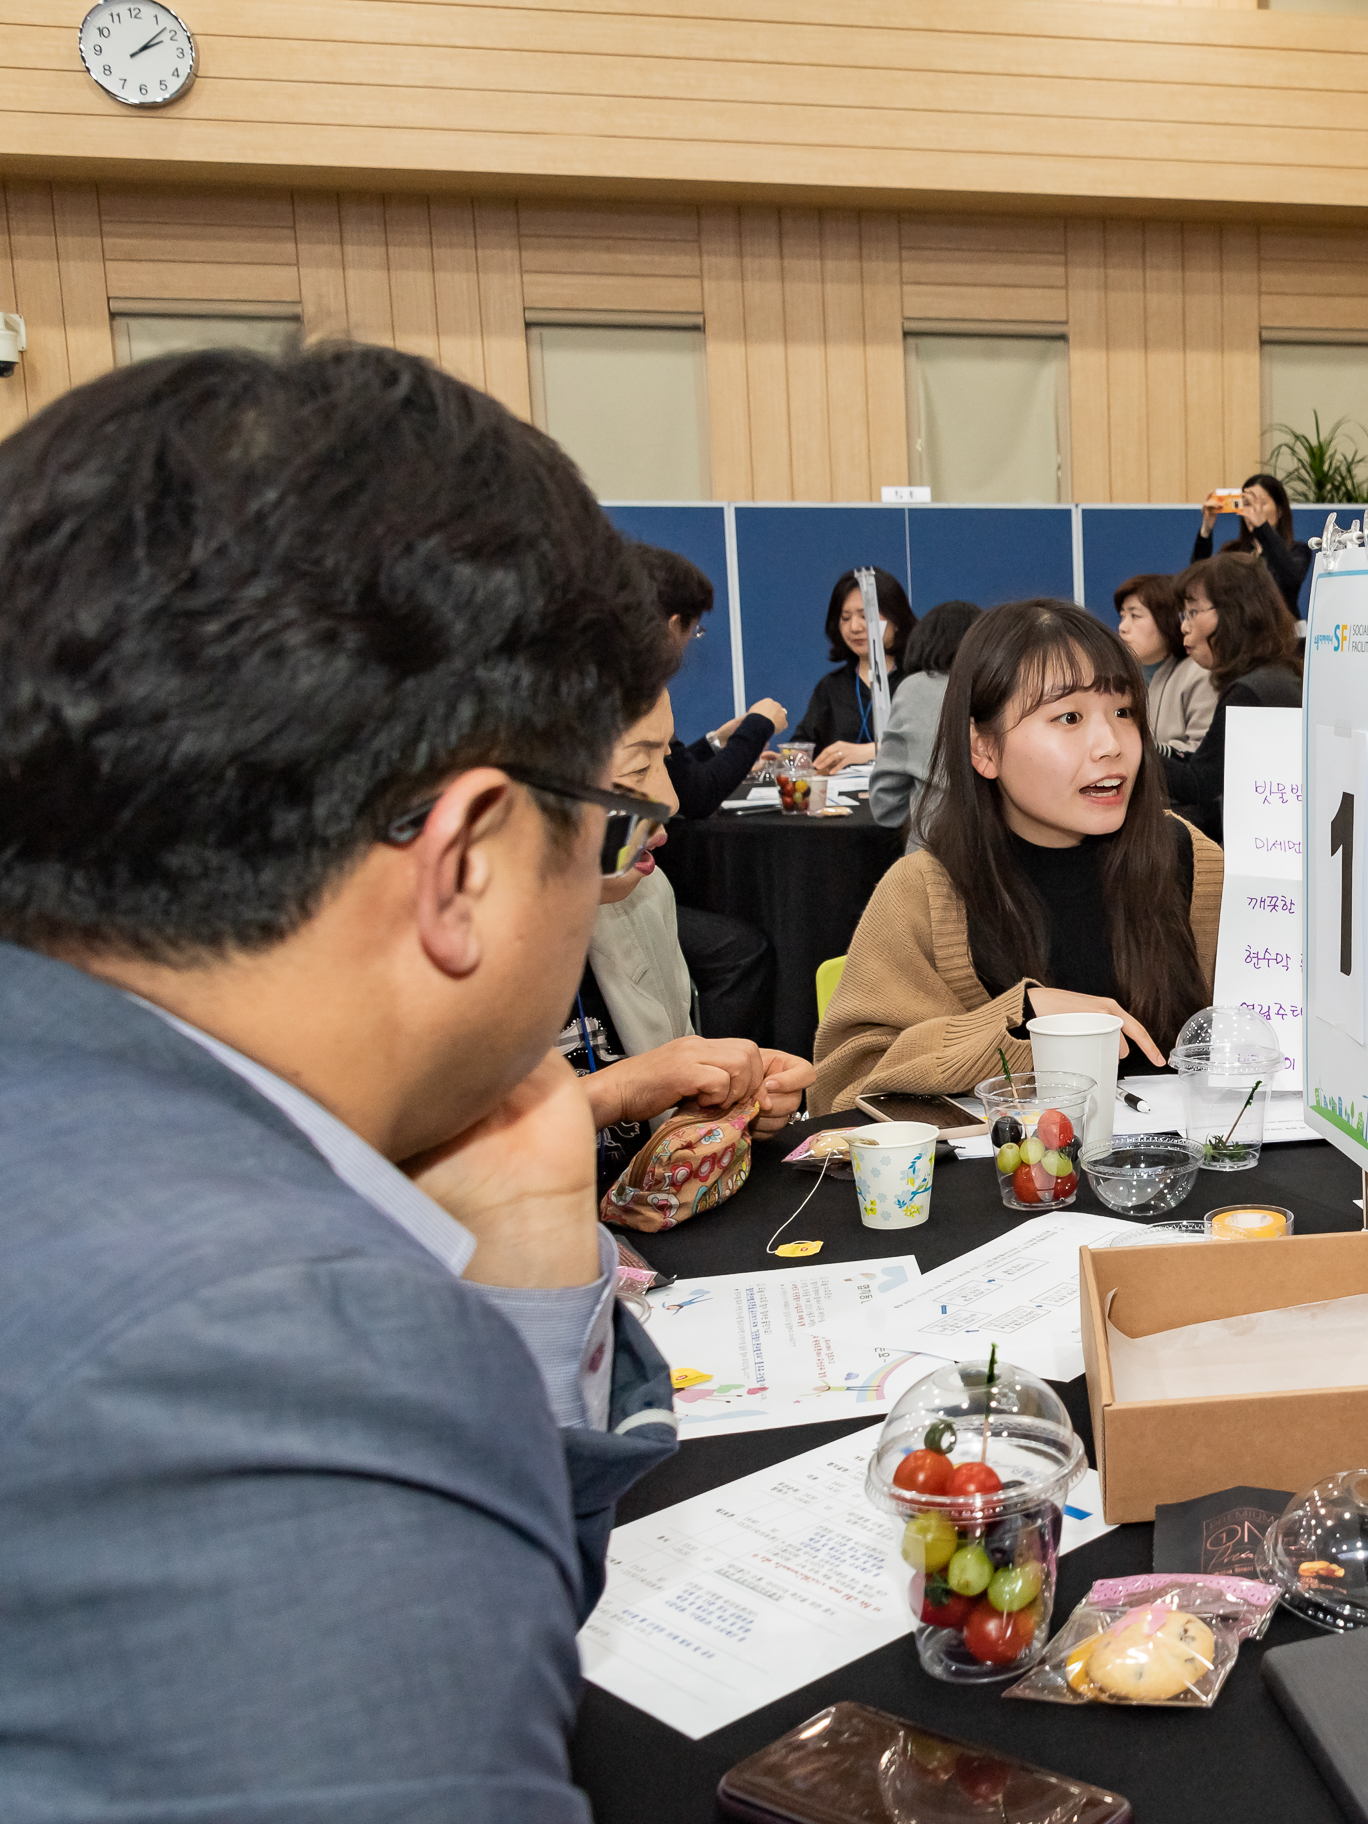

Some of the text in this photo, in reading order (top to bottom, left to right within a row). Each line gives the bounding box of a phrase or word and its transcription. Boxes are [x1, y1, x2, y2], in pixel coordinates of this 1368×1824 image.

[109, 12, 121, 24] 11
[127, 7, 142, 19] 12
[153, 14, 159, 25] 1
[96, 26, 110, 38] 10
[169, 30, 178, 41] 2
[93, 44, 102, 56] 9
[176, 47, 185, 59] 3
[102, 64, 112, 76] 8
[172, 68, 180, 78] 4
[119, 79, 127, 89] 7
[139, 84, 148, 95] 6
[159, 80, 168, 91] 5
[1333, 624, 1348, 652] SF
[1329, 791, 1355, 977] 1
[1244, 944, 1292, 971] 현수막
